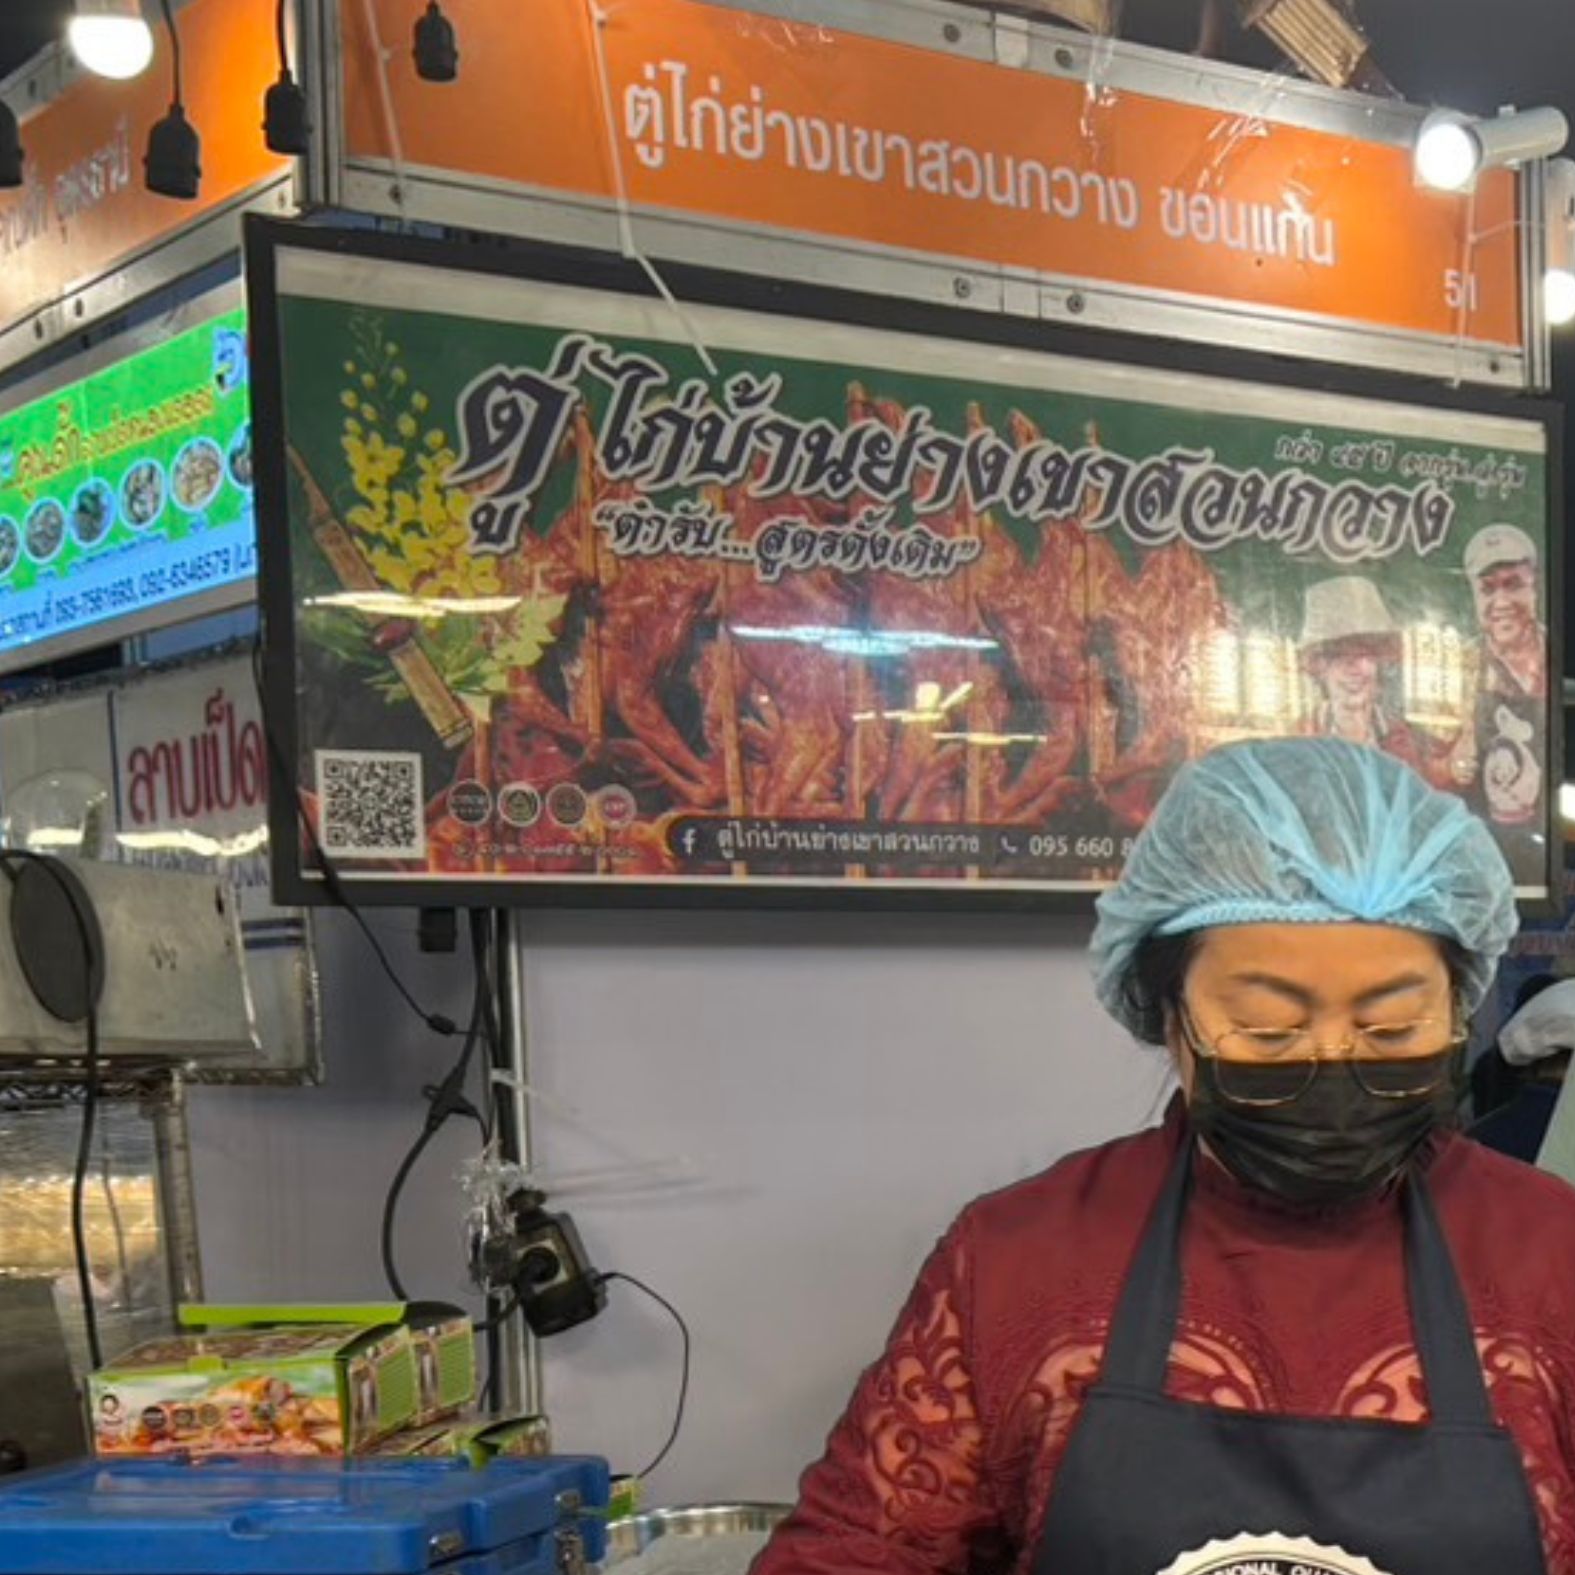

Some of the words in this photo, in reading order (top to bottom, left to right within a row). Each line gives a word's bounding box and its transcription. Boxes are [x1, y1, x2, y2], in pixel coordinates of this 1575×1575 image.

[623, 60, 1139, 230] ตู่ไก่ย่างเขาสวนกวาง
[1029, 834, 1068, 856] 095
[1075, 836, 1114, 858] 660
